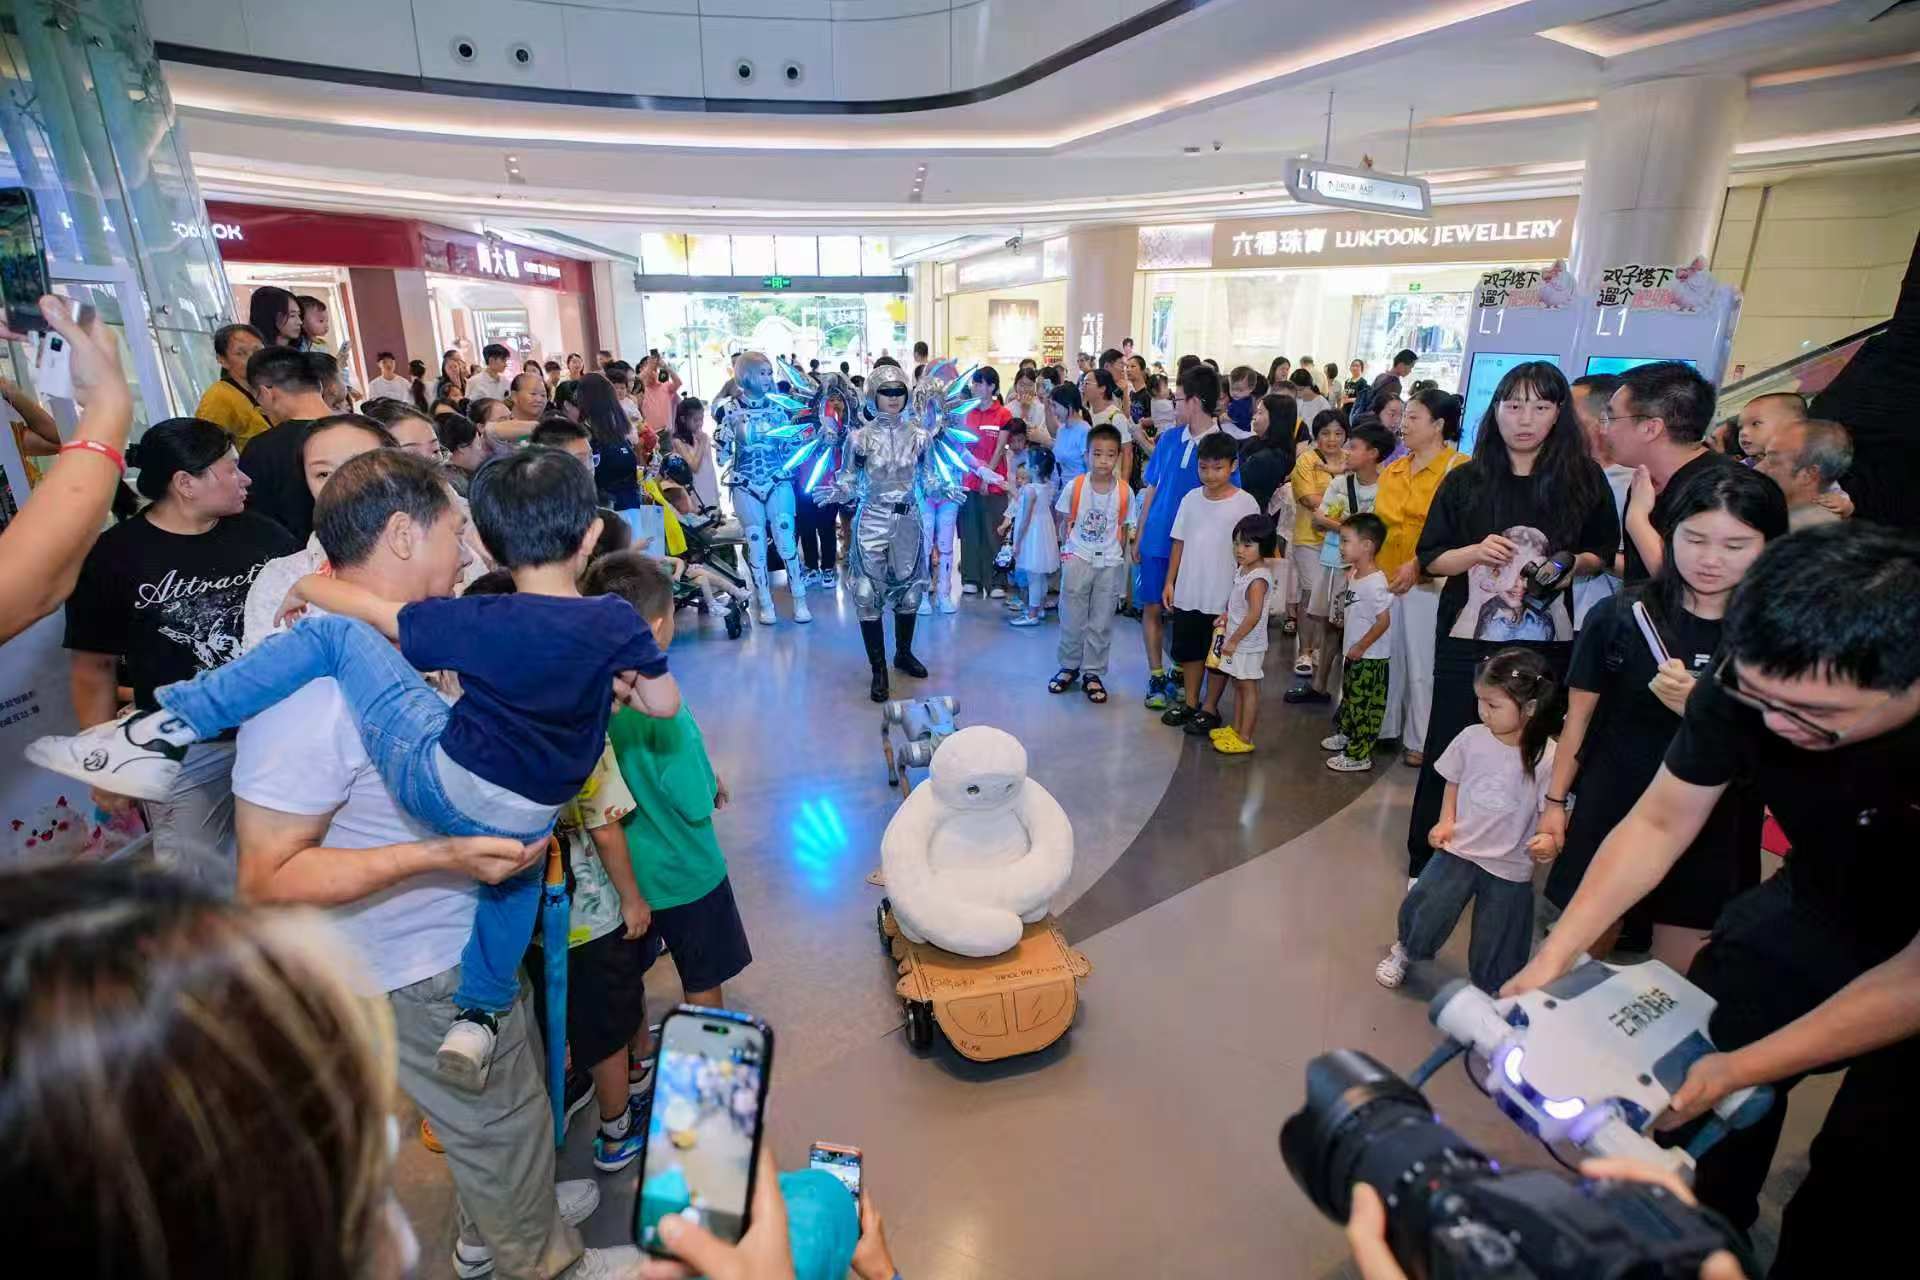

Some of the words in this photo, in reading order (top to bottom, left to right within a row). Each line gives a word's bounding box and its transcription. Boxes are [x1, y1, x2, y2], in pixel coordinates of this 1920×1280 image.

[1297, 168, 1316, 190] L1
[1336, 226, 1429, 248] LUKFOOK
[1431, 219, 1562, 247] JEWELLERY
[1603, 264, 1673, 289] 双子塔下
[1479, 309, 1505, 335] L1
[1596, 308, 1629, 337] L1
